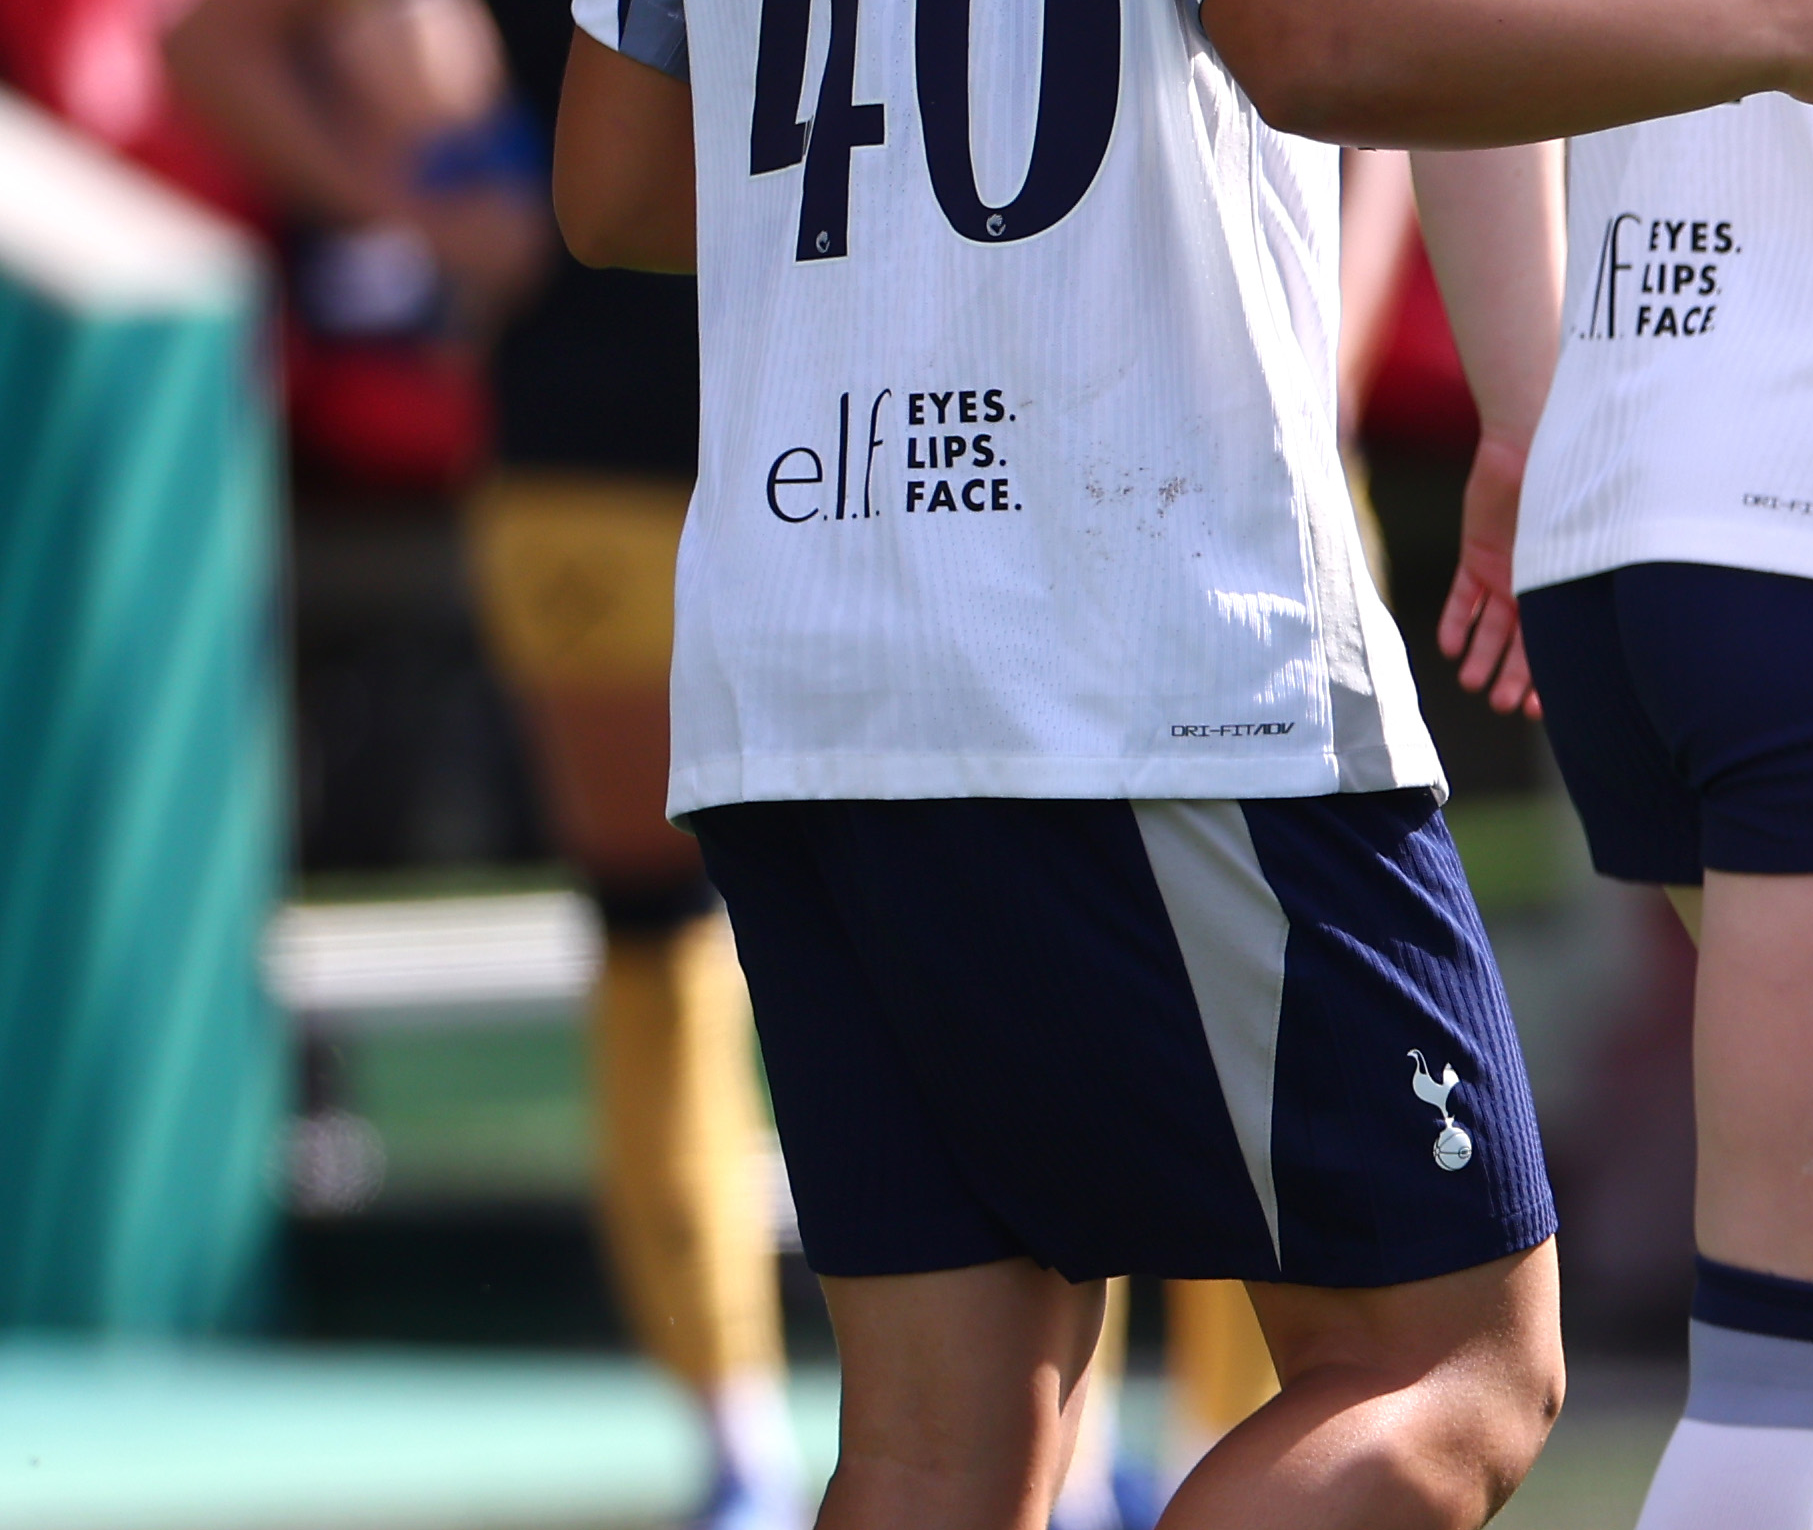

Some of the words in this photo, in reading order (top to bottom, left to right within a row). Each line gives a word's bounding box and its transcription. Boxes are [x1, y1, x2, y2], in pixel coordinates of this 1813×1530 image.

[1649, 219, 1742, 254] EYES.
[908, 389, 1016, 425] EYES.
[907, 434, 1007, 469] LIPS.
[906, 478, 1022, 512] FACE.
